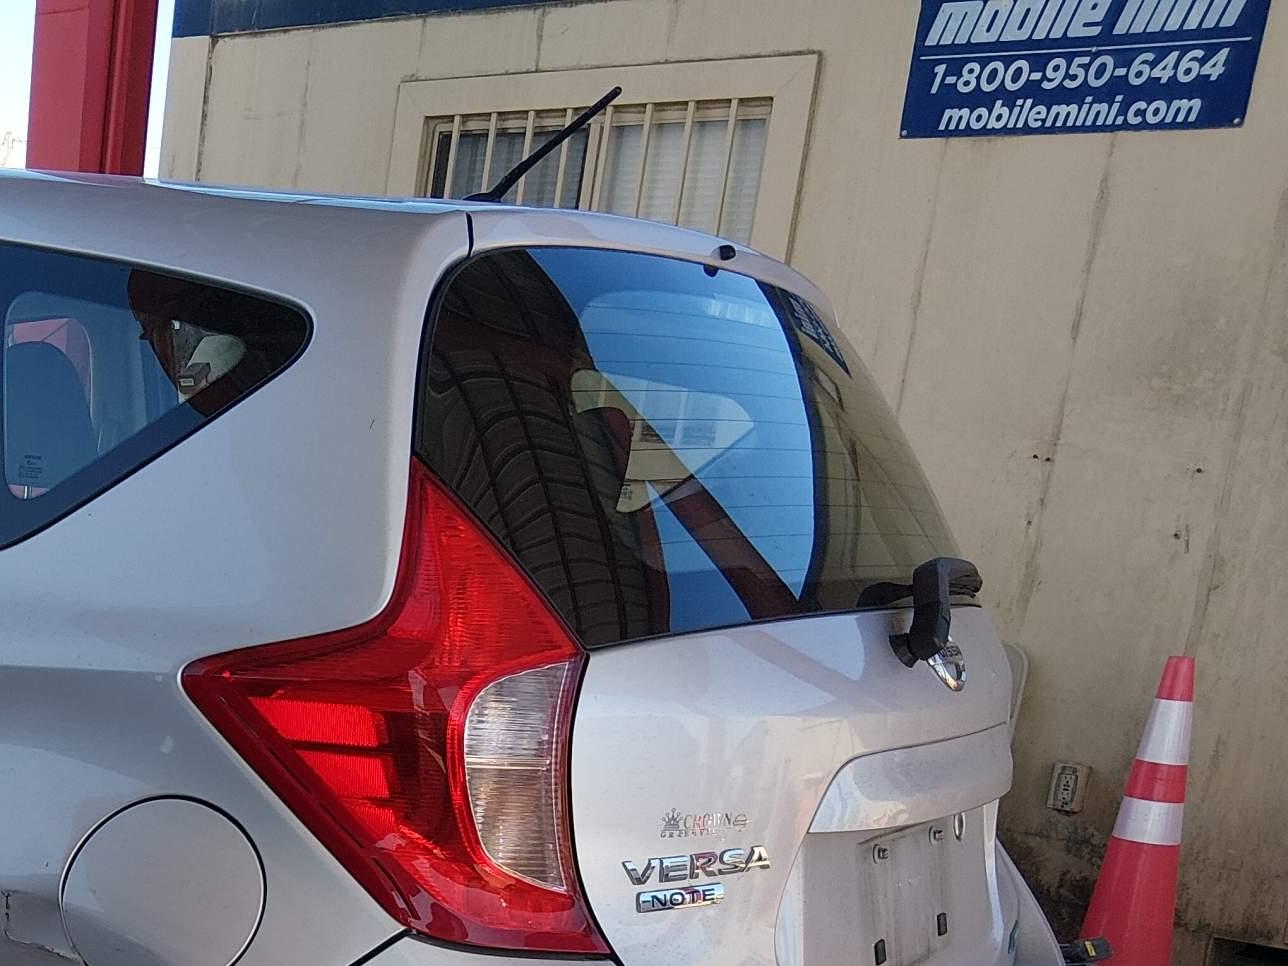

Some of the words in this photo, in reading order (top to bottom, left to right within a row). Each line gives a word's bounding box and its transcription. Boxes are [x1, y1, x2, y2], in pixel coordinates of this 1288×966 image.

[930, 48, 1231, 94] 1-800-950-6464
[938, 95, 1202, 131] mobilemini.com
[622, 845, 771, 885] VERSA
[649, 886, 718, 909] NOTE
